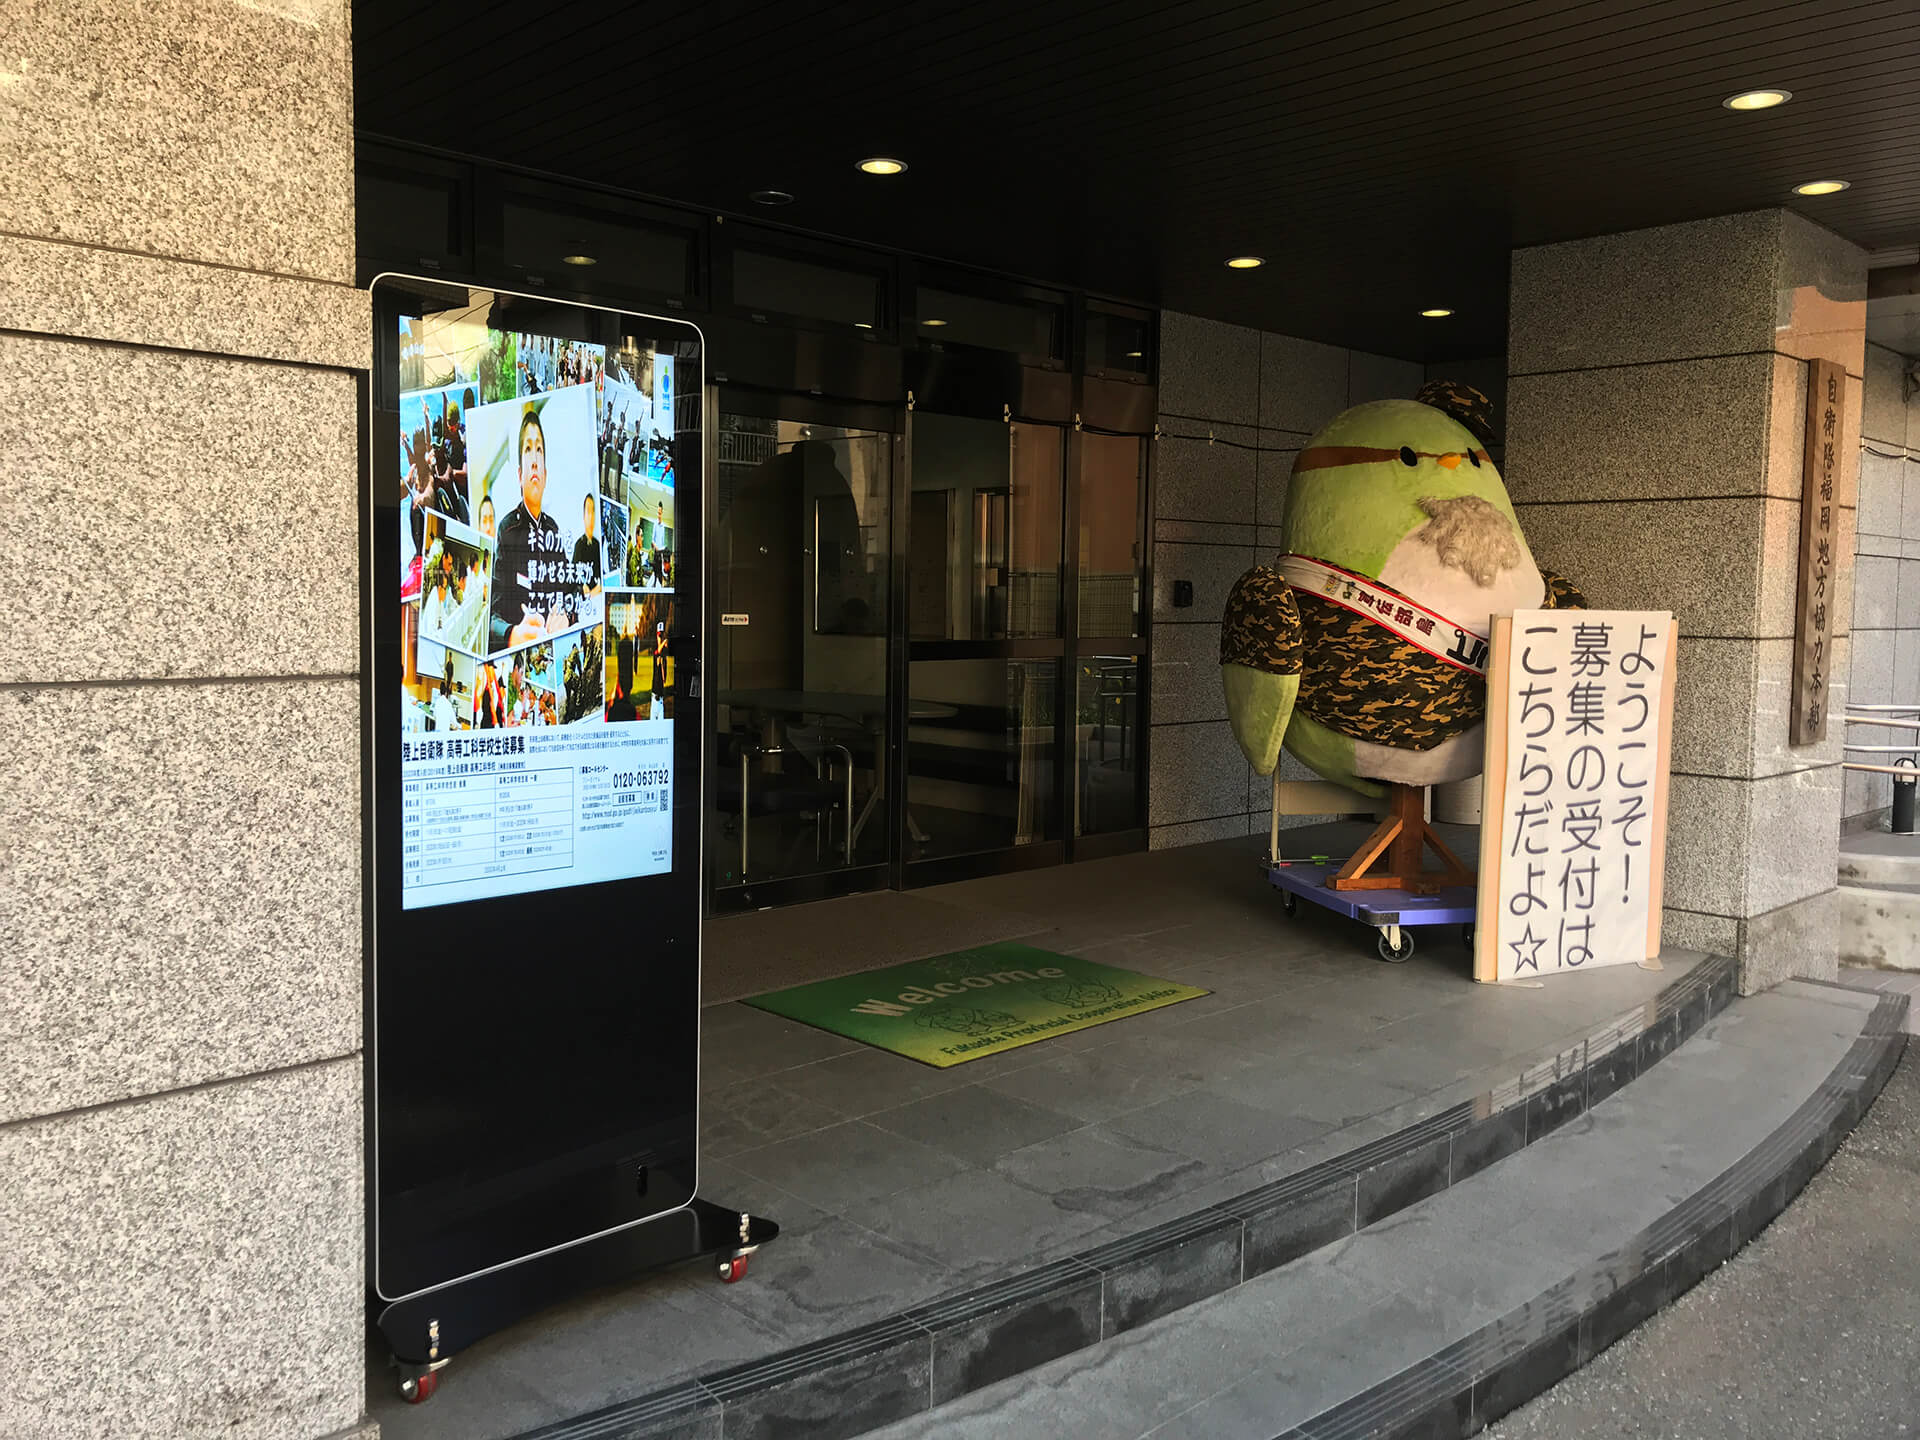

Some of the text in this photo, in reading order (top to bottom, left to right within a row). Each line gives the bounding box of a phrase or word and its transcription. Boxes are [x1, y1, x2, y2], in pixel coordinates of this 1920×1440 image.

[1807, 375, 1837, 733] 自衛隊福岡地方協力本部
[527, 591, 598, 617] ここで見つかる。
[446, 735, 526, 759] 高等工科学校生徒募集
[1557, 621, 1613, 969] 募集の受付は
[851, 966, 1065, 1017] Welcome
